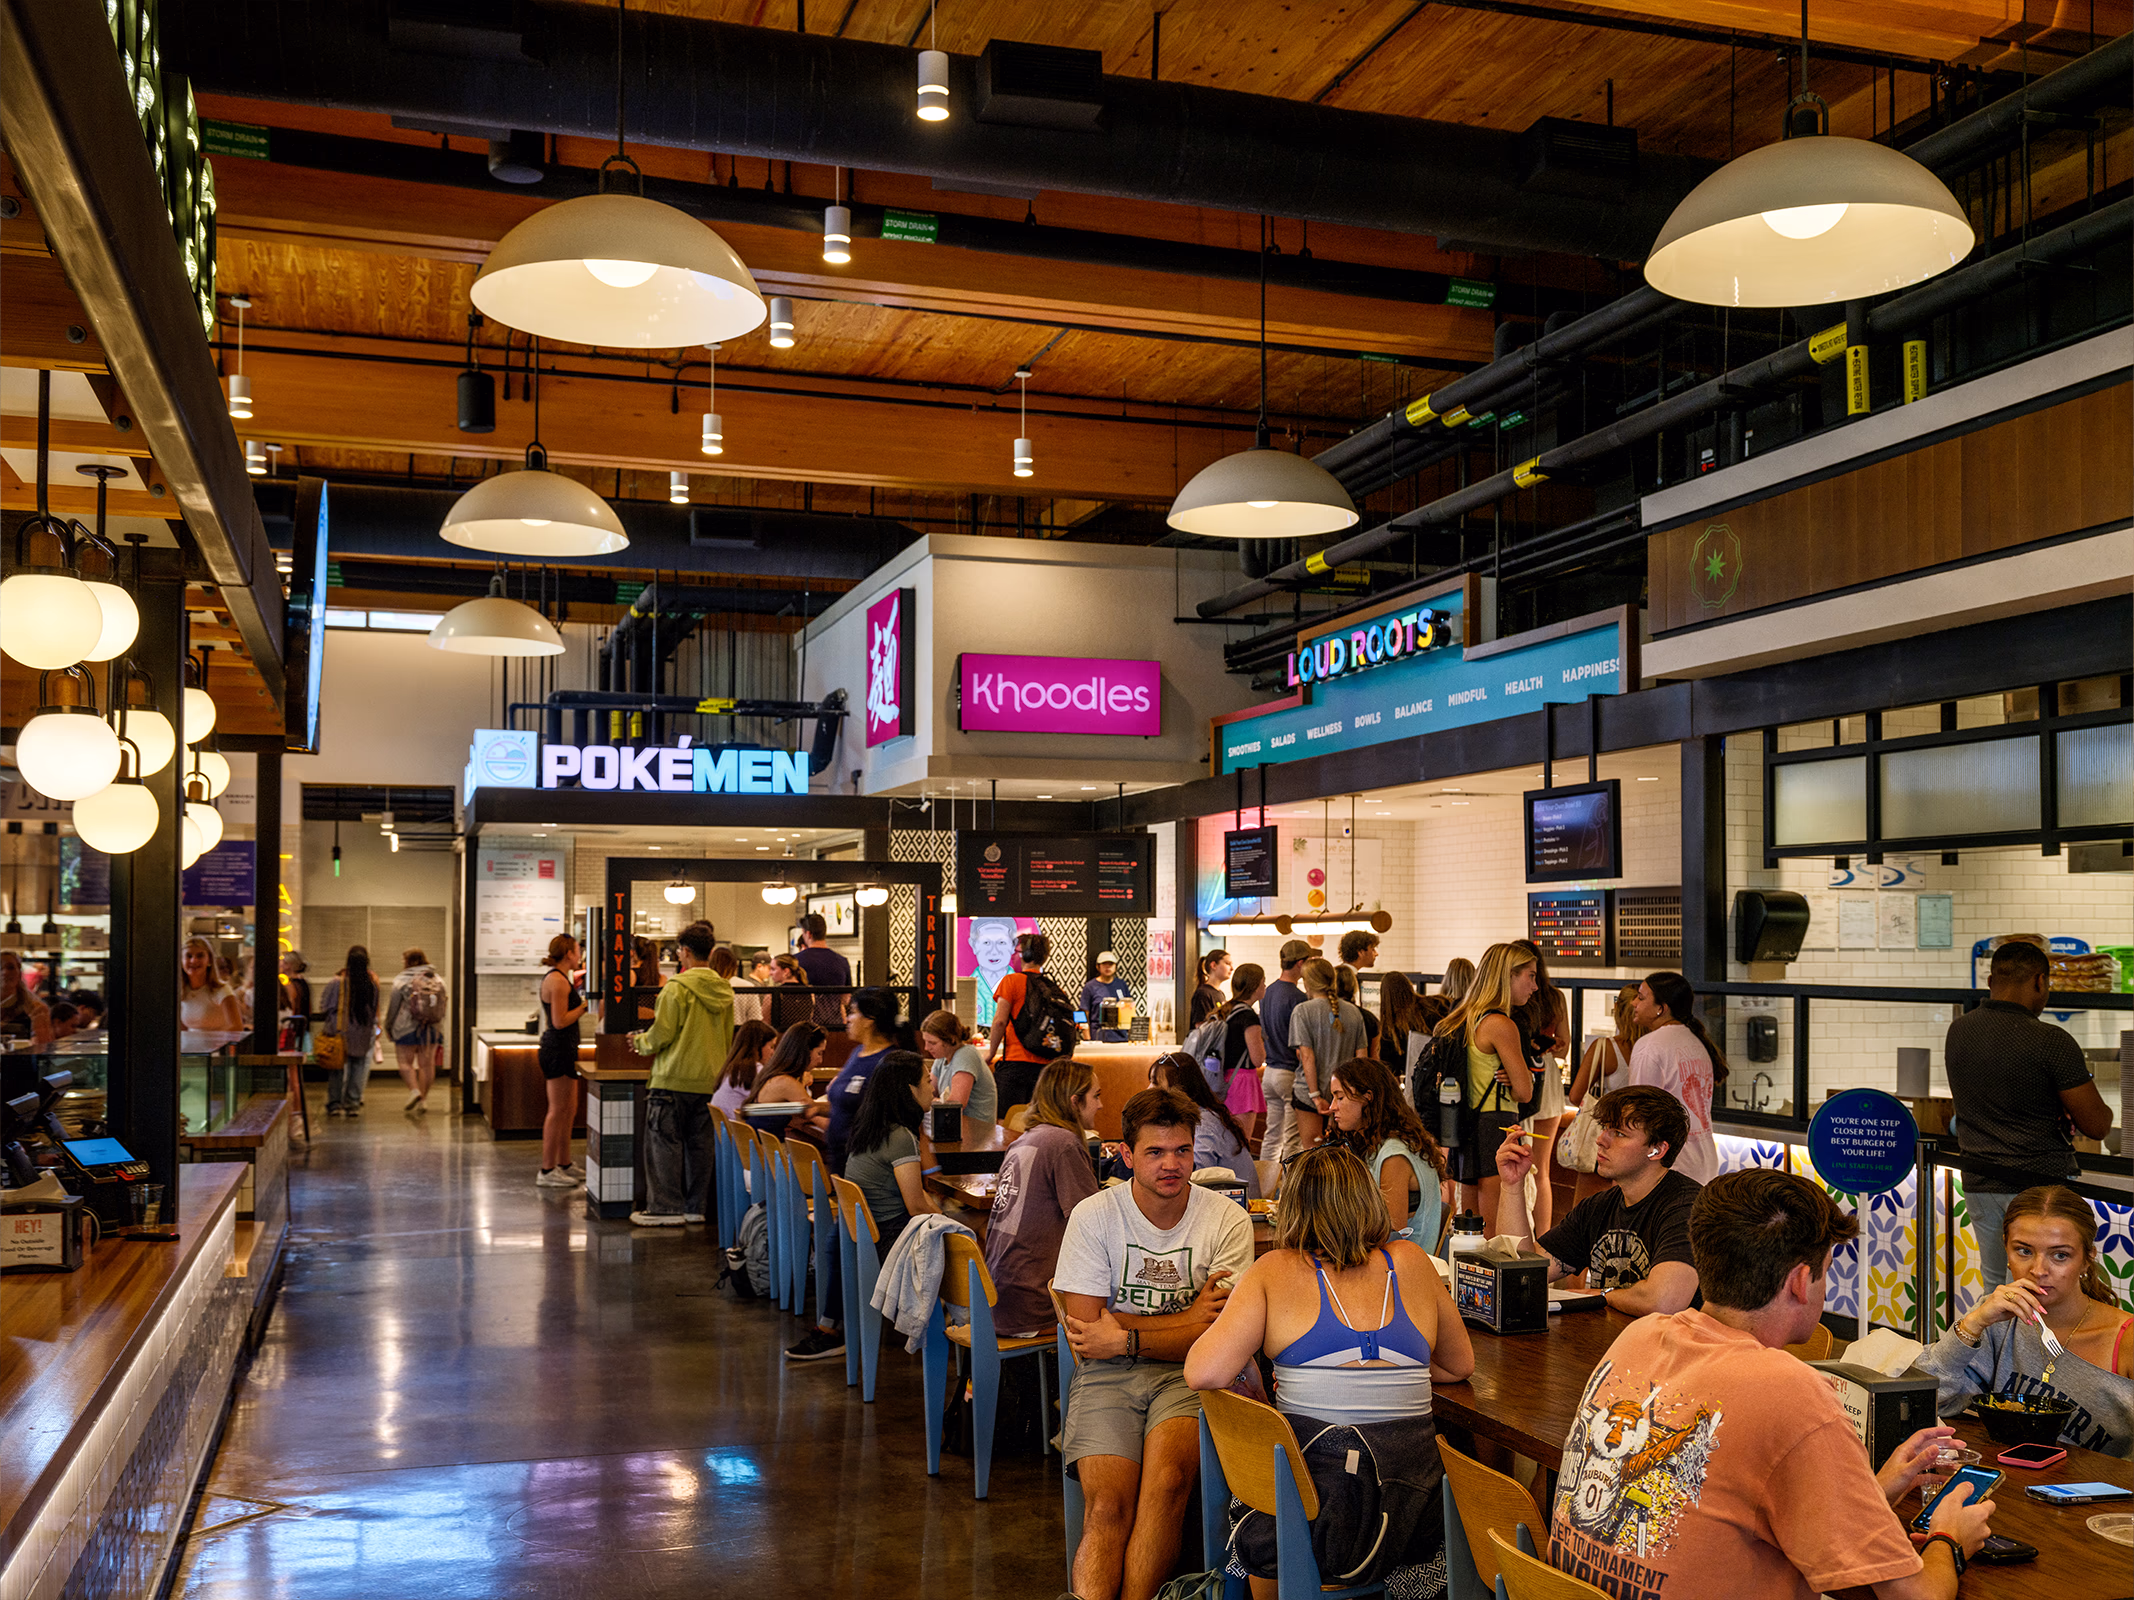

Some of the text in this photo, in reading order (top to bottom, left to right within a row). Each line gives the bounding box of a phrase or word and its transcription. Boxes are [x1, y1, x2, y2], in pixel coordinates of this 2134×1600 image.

[207, 128, 258, 144] STORM DRAIN
[885, 219, 929, 231] STORM DRAIN
[1451, 285, 1470, 295] STORM
[1910, 365, 1919, 378] WATER
[1853, 377, 1862, 391] WATER
[1288, 608, 1434, 687] LOUD ROOTS
[972, 673, 1150, 716] Khoodles
[1228, 657, 1619, 758] SMOOTHIES SALADS WELLNESS BOWLS BALANCE MINDFUL HEALTH HAPPINESS
[542, 734, 809, 794] POKÉMEN
[614, 893, 625, 992] TRAYS
[926, 895, 936, 990] TRAYS
[1830, 1116, 1900, 1127] YOU'RE ONE STEP
[1833, 1127, 1864, 1135] CLOSER
[1852, 1139, 1884, 1147] BURGER
[1886, 1140, 1897, 1148] OF
[1842, 1148, 1885, 1158] YOUR LIFE!
[1849, 1162, 1873, 1170] STARTS
[15, 1219, 42, 1234] HEY!
[1843, 1403, 1862, 1416] KEEP
[2001, 1371, 2114, 1453] AURN
[1586, 1483, 1603, 1512] 01
[1552, 1518, 1669, 1591] SEC TOURNAMENT
